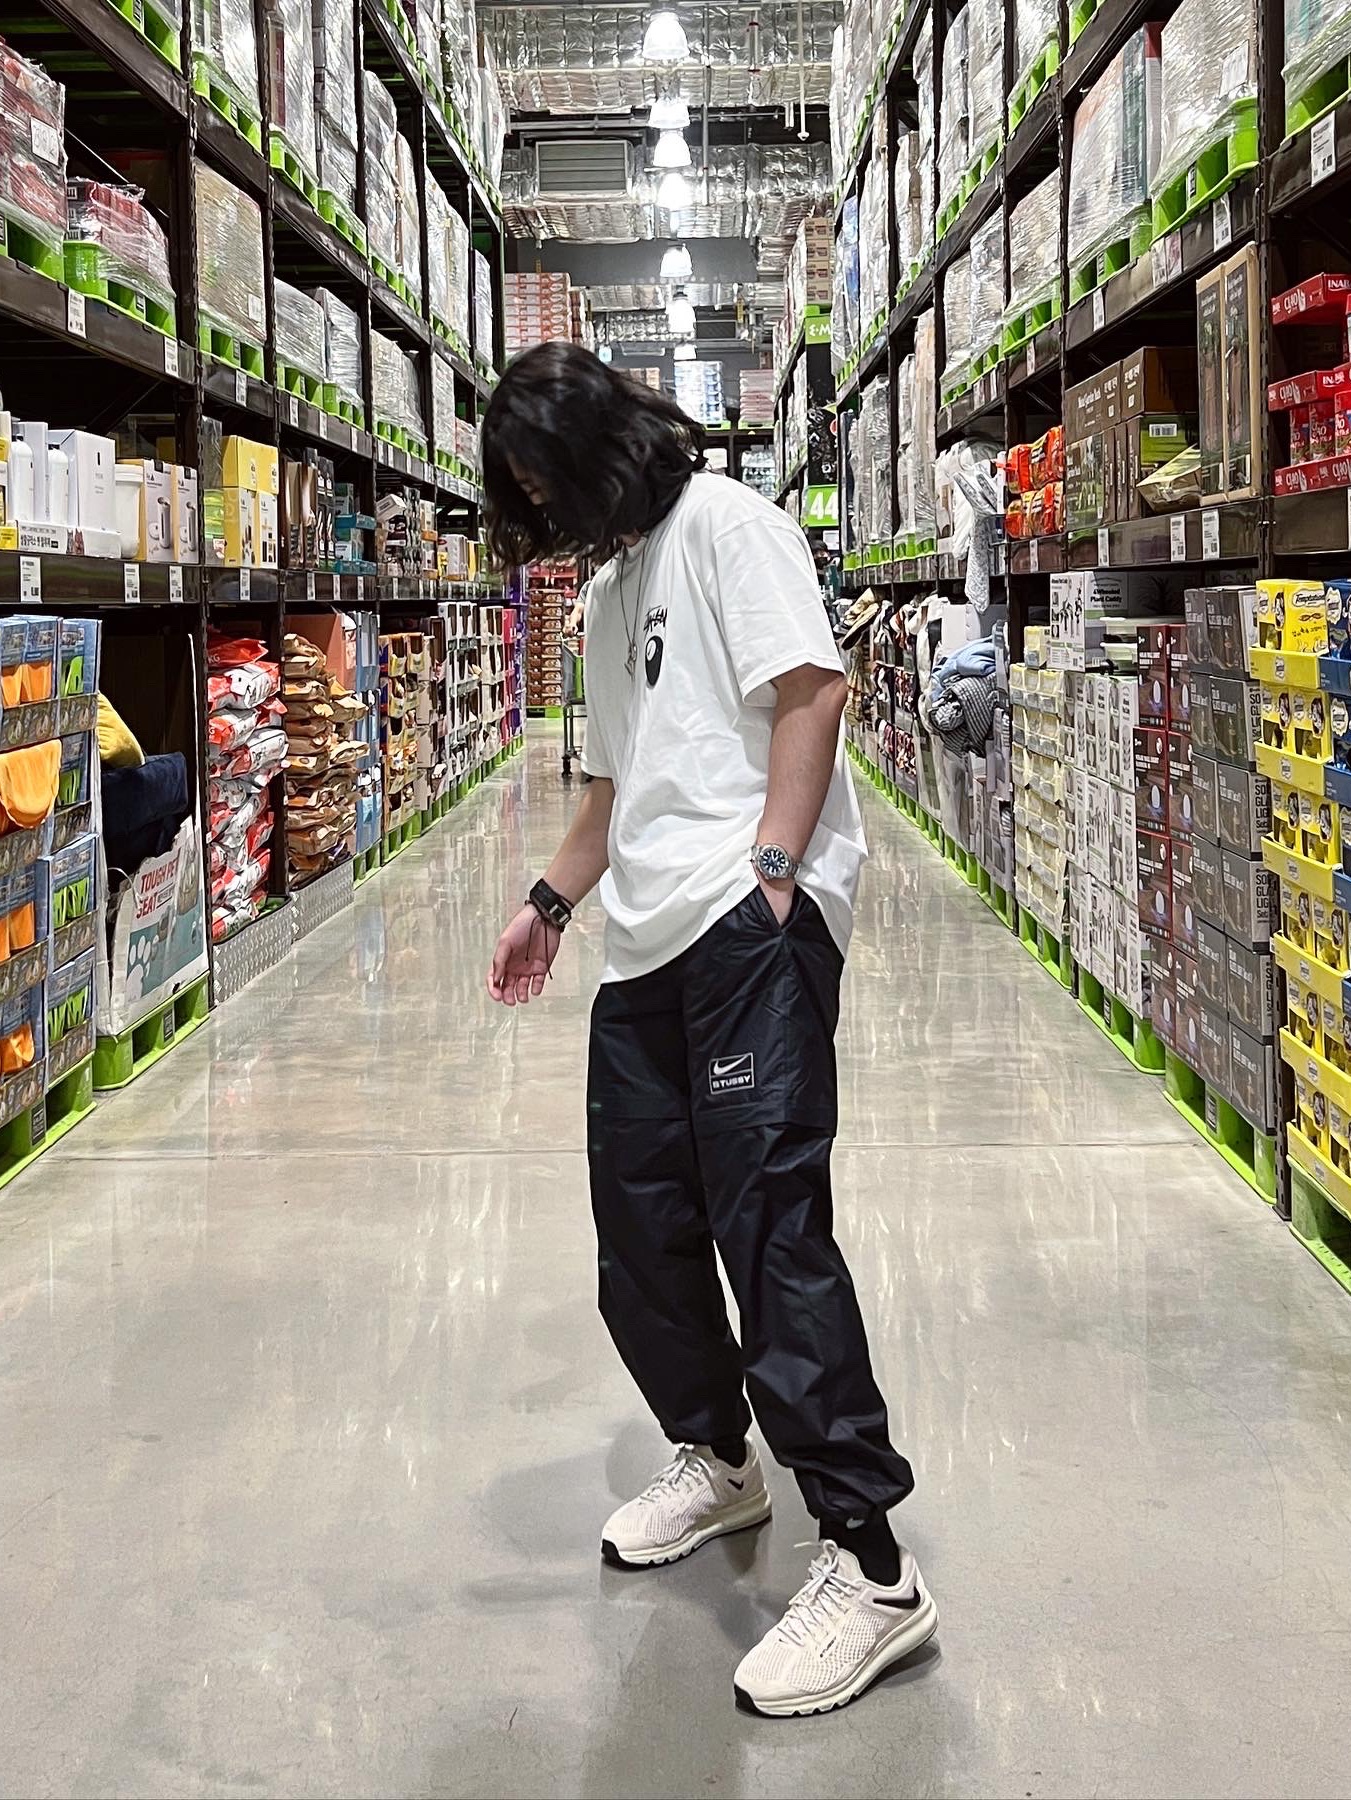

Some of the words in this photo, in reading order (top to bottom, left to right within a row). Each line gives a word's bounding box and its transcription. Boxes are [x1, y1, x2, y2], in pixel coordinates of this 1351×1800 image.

[1328, 279, 1351, 289] INAB
[810, 491, 838, 520] 44
[712, 1074, 751, 1089] STUSSY
